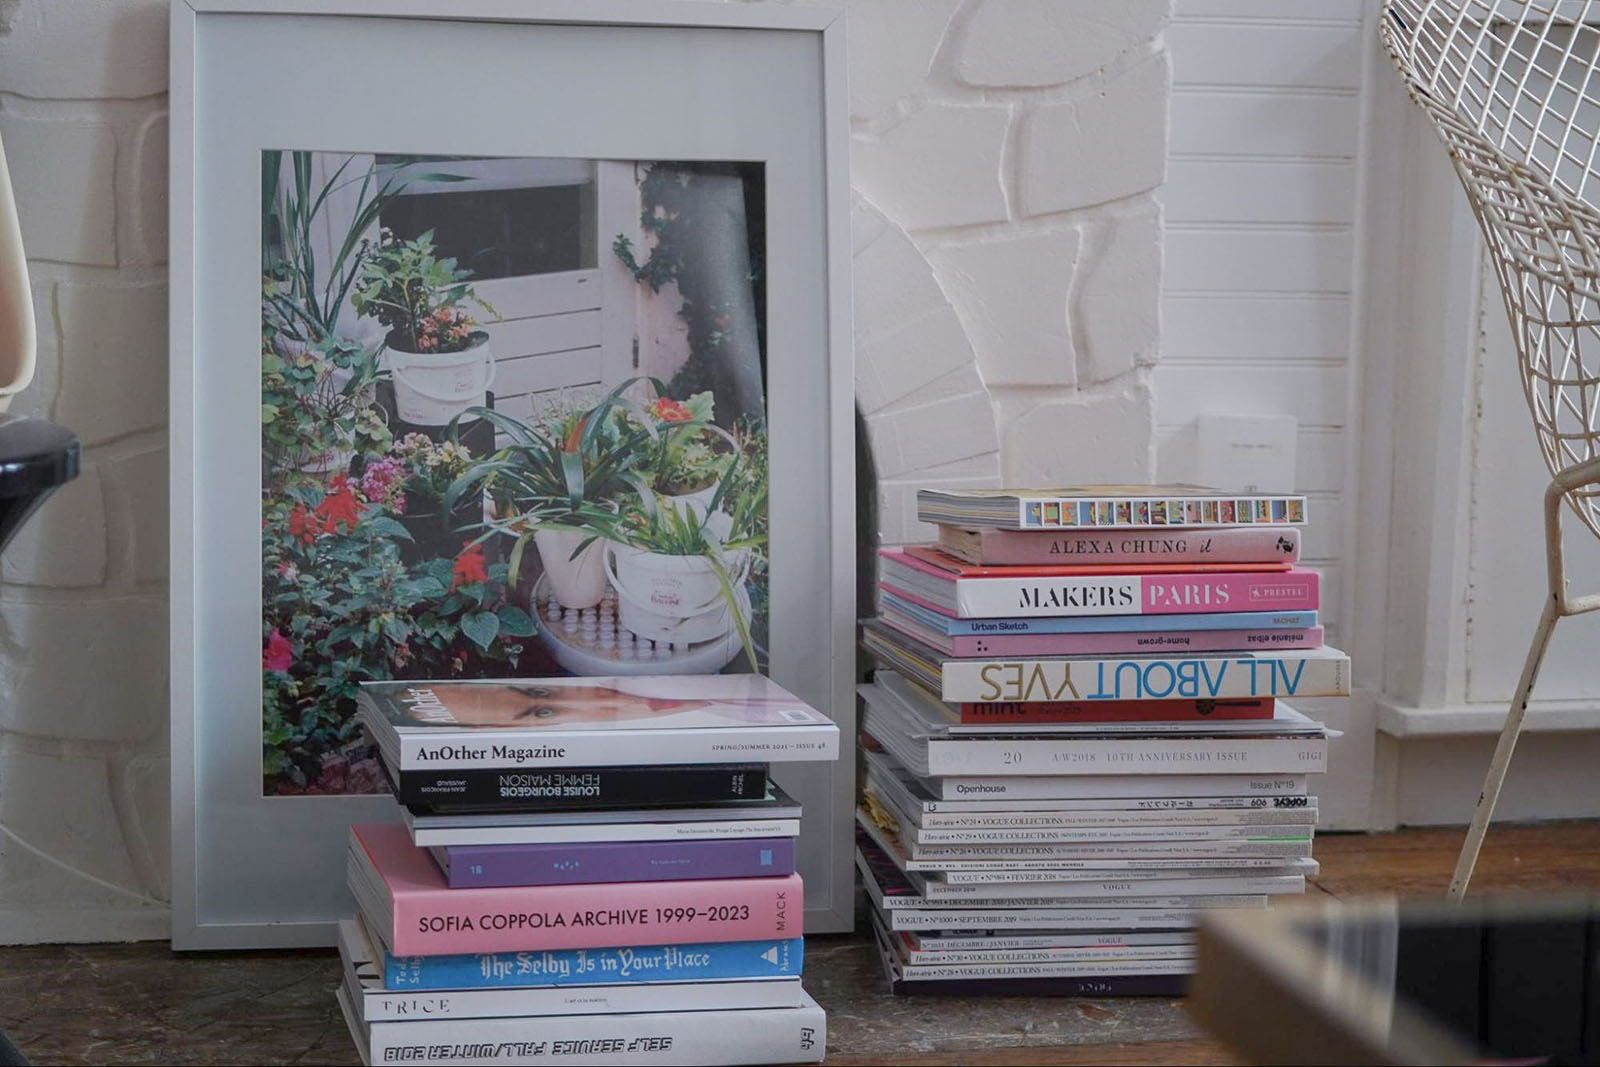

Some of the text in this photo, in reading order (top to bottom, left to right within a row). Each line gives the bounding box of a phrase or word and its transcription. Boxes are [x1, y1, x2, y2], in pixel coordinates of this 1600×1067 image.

[1050, 540, 1114, 554] ALEXA
[1121, 540, 1187, 553] CHUNG
[1019, 583, 1230, 608] MAKERS PARIS
[1263, 588, 1304, 597] PRESTEL
[971, 622, 1029, 632] Urban Sketch
[1137, 637, 1191, 647] home-grown
[980, 659, 1306, 701] ALL ABOUT YVES
[711, 743, 770, 751] SPRING/SUMMER
[416, 745, 566, 763] AnOther Magazine
[1003, 752, 1022, 764] 20
[1106, 752, 1134, 762] 10TH
[1138, 751, 1212, 762] ANNIVERSARY
[1216, 751, 1248, 761] ISSUE
[1298, 751, 1322, 761] GIGI
[500, 774, 600, 787] FEMME MAISON
[1250, 780, 1272, 789] Issue
[500, 786, 600, 797] LOUISE BOURGEOIS
[956, 784, 1007, 794] Openhouse
[1251, 798, 1267, 807] 909
[1273, 798, 1308, 808] POPEYE
[981, 817, 1009, 825] VOGUE
[1010, 816, 1063, 825] COLLECTIONS
[977, 832, 1004, 840] VOGUE
[1006, 831, 1059, 839] COLLECTIONS
[971, 847, 998, 855] VOGUE
[1000, 846, 1054, 854] COLLECTIONS
[952, 874, 979, 883] VOGUE
[889, 898, 919, 906] VOGUE
[776, 891, 786, 931] MACK
[419, 915, 474, 932] SOFIA
[479, 912, 566, 930] COPPOLA
[571, 909, 648, 927] ARCHIVE
[896, 916, 924, 925] VOGUE
[958, 915, 1003, 924] SEPTEMBRE
[1098, 937, 1122, 945] VOGUE
[968, 953, 997, 961] VOGUE
[998, 952, 1050, 961] COLLECTIONS
[479, 946, 711, 980] The Selby Is in Your Place
[959, 968, 986, 976] VOGUE
[987, 967, 1041, 975] COLLECTIONS
[381, 999, 450, 1014] TRICE
[384, 1037, 673, 1061] SELF SERVICE FALL/WINTER 2018
